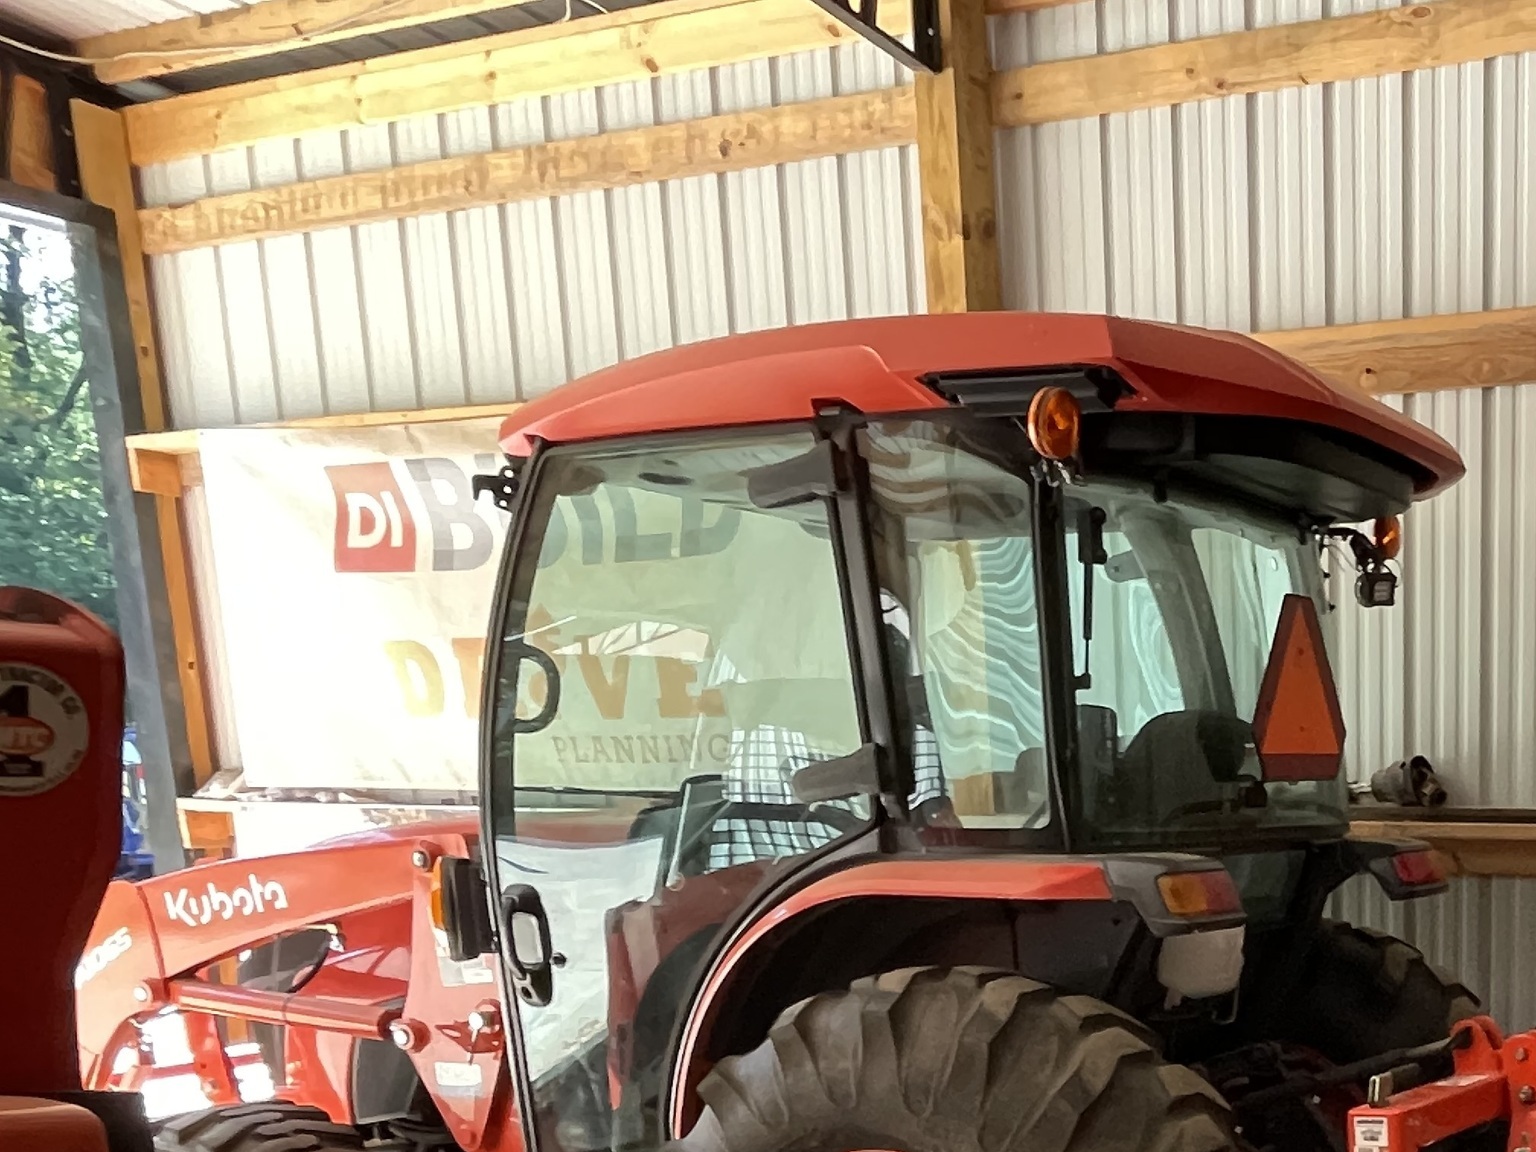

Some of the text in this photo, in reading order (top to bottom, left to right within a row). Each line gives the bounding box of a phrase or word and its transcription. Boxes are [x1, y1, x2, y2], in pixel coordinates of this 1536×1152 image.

[347, 490, 404, 549] DI
[552, 734, 732, 764] PLANNING
[164, 874, 289, 927] Kubota
